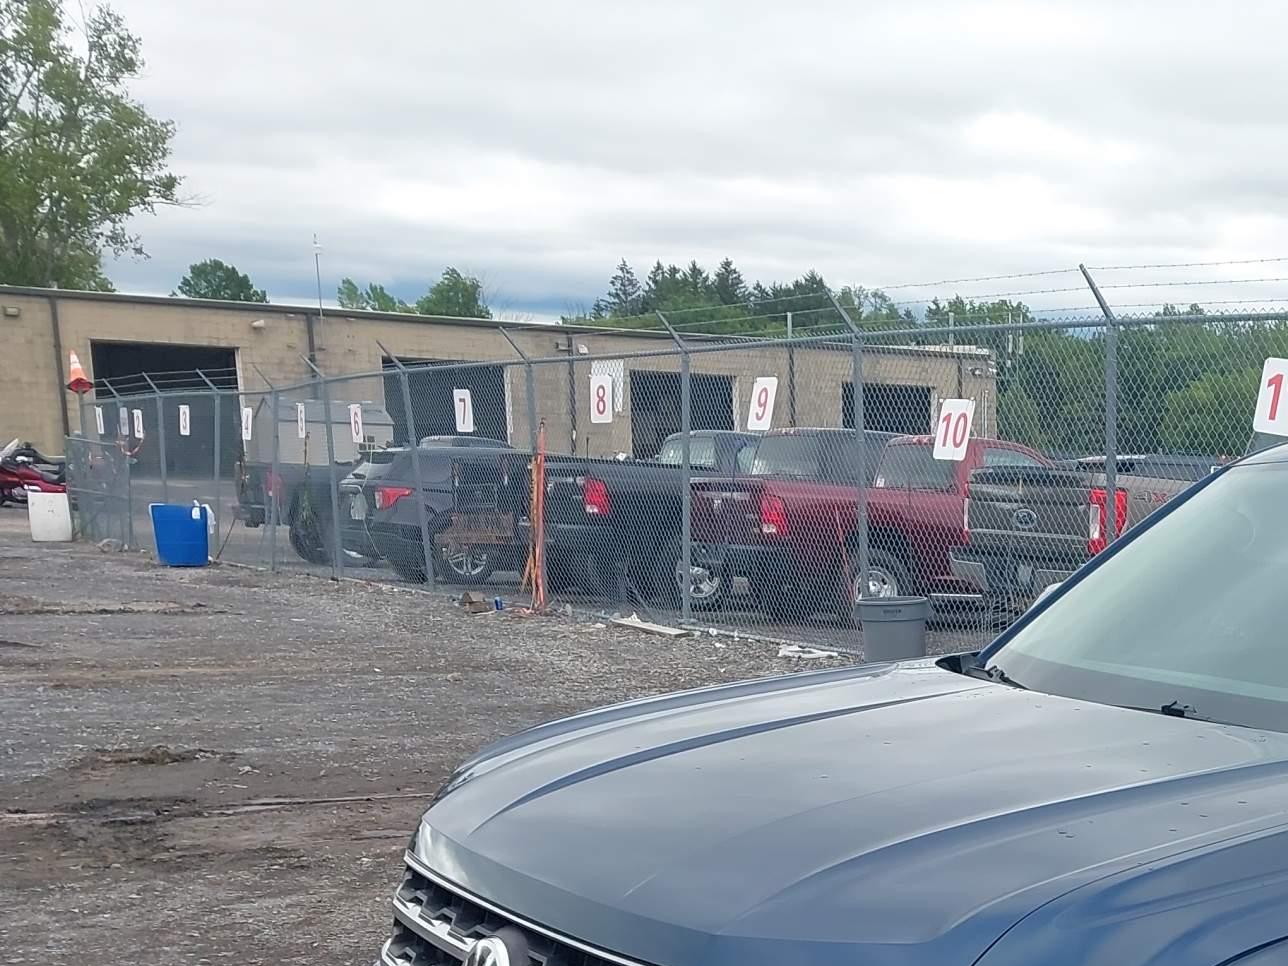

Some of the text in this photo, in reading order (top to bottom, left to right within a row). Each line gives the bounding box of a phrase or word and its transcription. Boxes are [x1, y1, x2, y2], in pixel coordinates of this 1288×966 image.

[459, 398, 466, 425] 7
[596, 384, 606, 415] 8
[755, 387, 769, 421] 9
[353, 411, 360, 436] 6
[941, 412, 968, 449] 10
